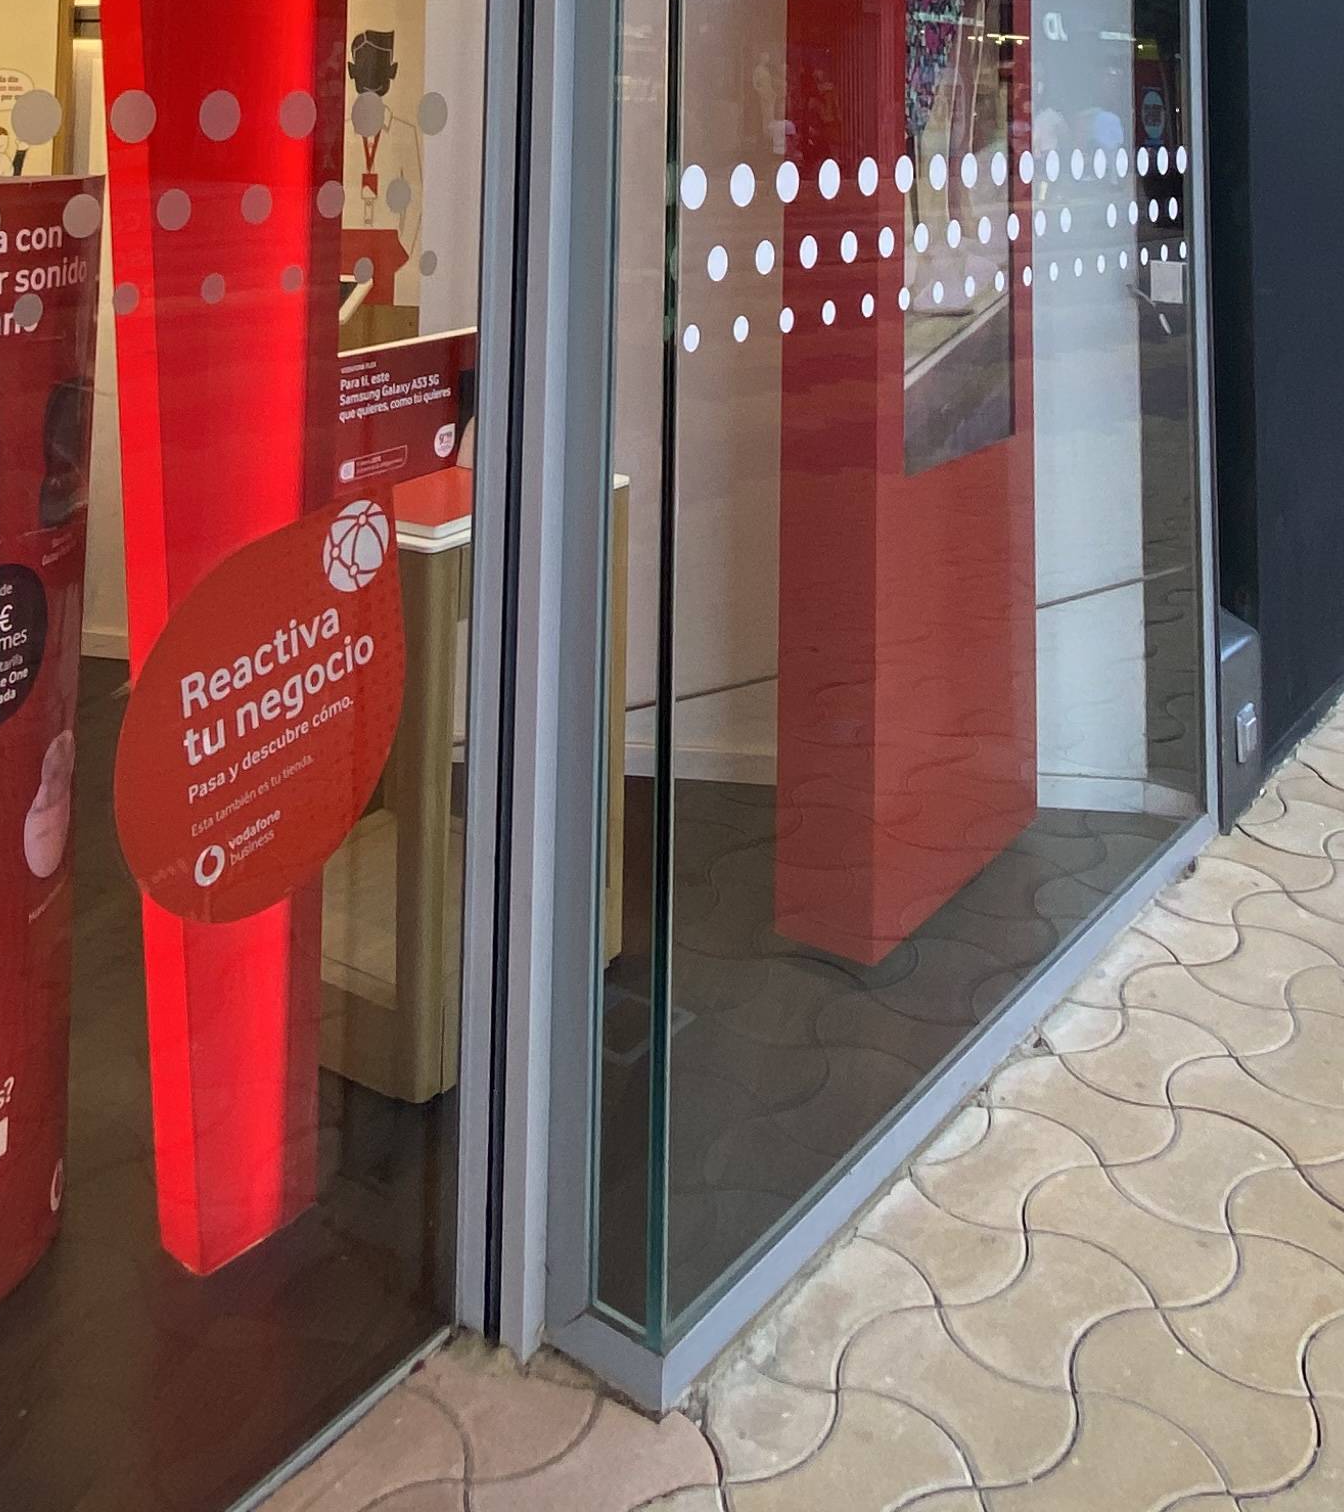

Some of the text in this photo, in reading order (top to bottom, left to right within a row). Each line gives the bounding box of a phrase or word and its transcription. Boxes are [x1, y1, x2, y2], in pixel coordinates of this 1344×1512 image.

[16, 225, 62, 252] con
[15, 256, 87, 291] sonido
[340, 377, 360, 391] Para
[370, 372, 390, 385] este
[340, 389, 381, 406] Samsung
[381, 381, 410, 396] Galaxy
[428, 374, 440, 385] 5G
[339, 409, 356, 424] que
[390, 397, 413, 409] como
[423, 387, 452, 403] quieres
[8, 666, 29, 683] One
[180, 607, 340, 719] Reactiva
[184, 633, 375, 767] tu negocio
[187, 697, 354, 804] Pasa y descubre cómo.
[191, 815, 214, 838] Esta
[217, 788, 256, 823] también
[228, 809, 281, 849] vodafone
[229, 829, 275, 867] business
